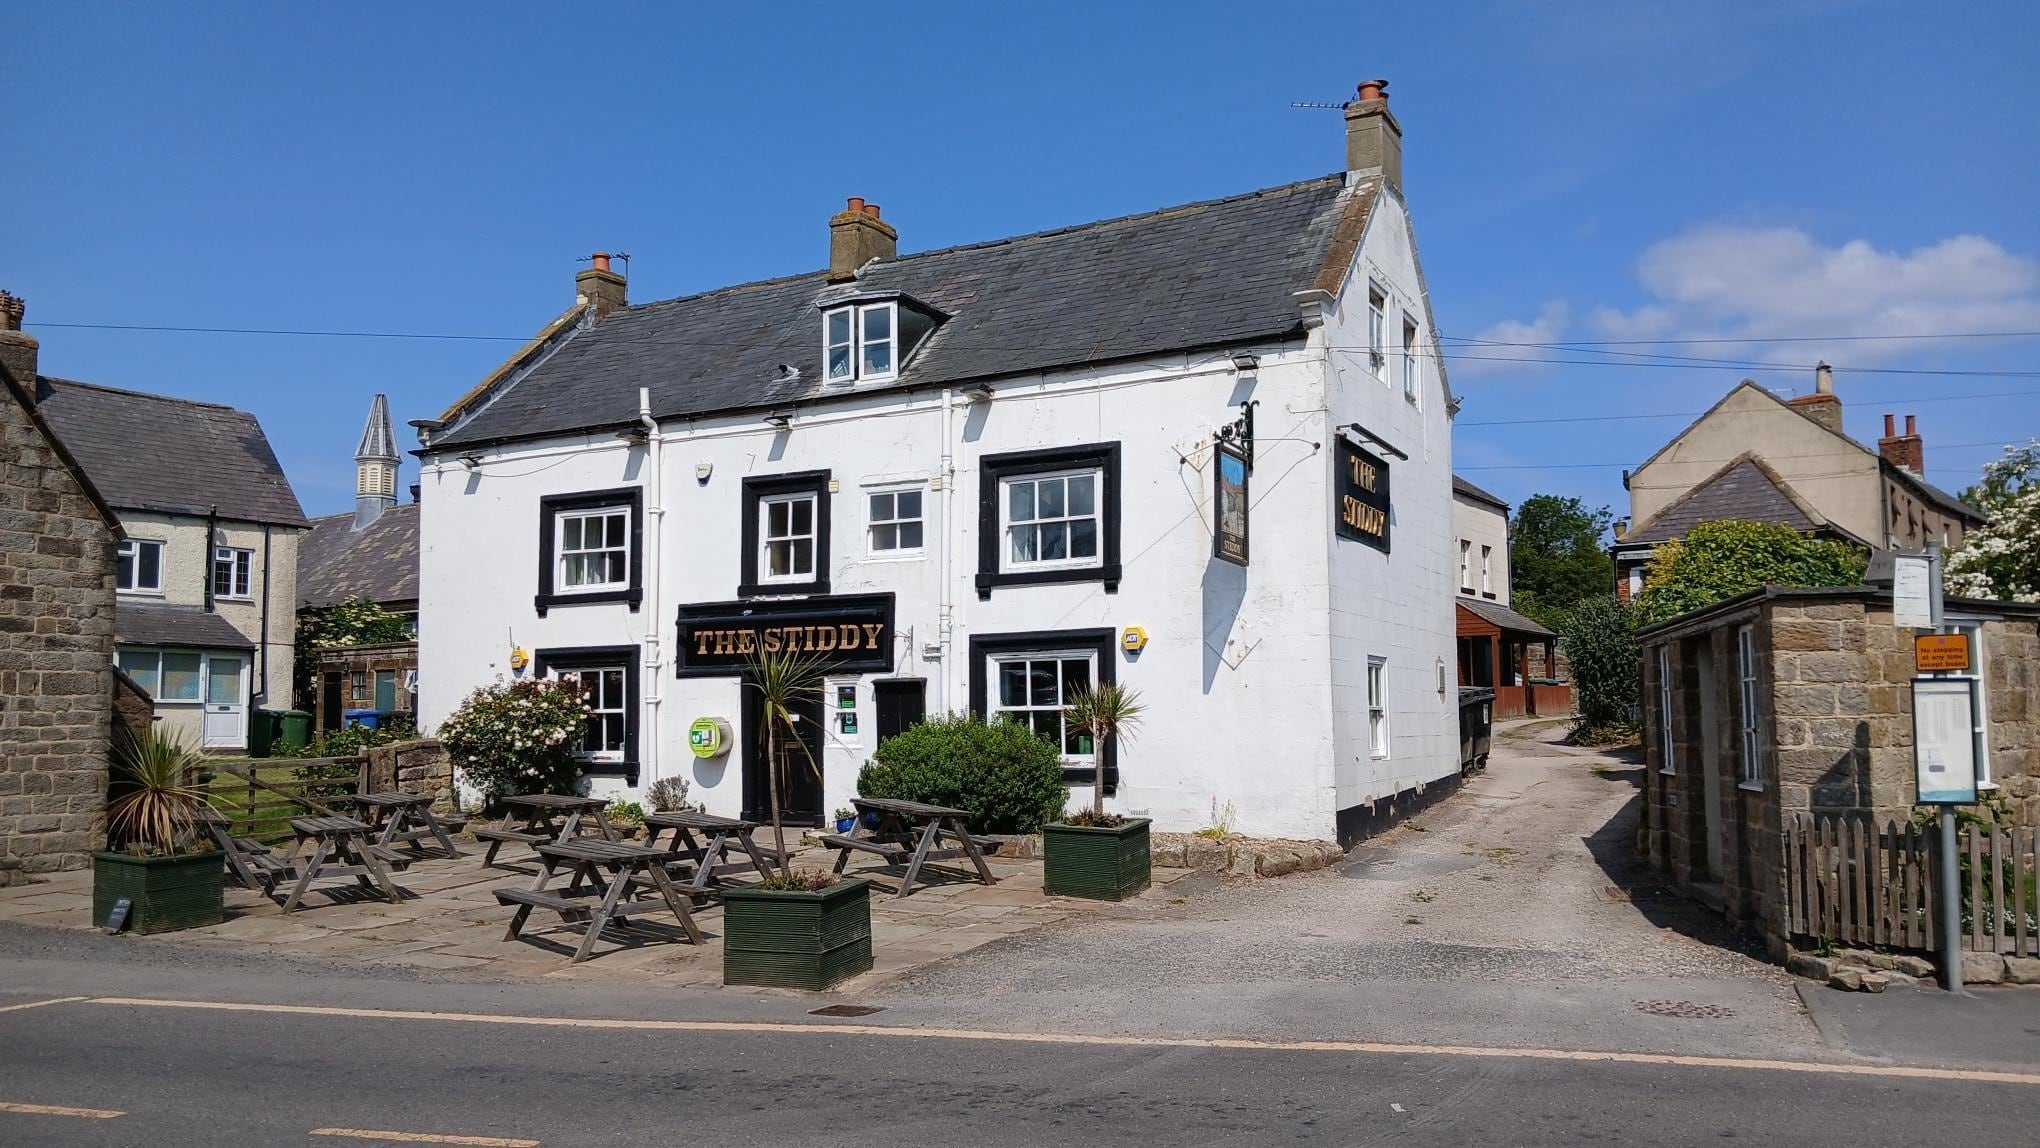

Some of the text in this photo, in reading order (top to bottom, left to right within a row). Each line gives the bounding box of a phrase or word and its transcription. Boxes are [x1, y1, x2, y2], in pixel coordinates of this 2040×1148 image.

[1350, 455, 1376, 493] THE
[1343, 494, 1385, 537] STIDDY
[694, 623, 884, 655] THE STIDDY
